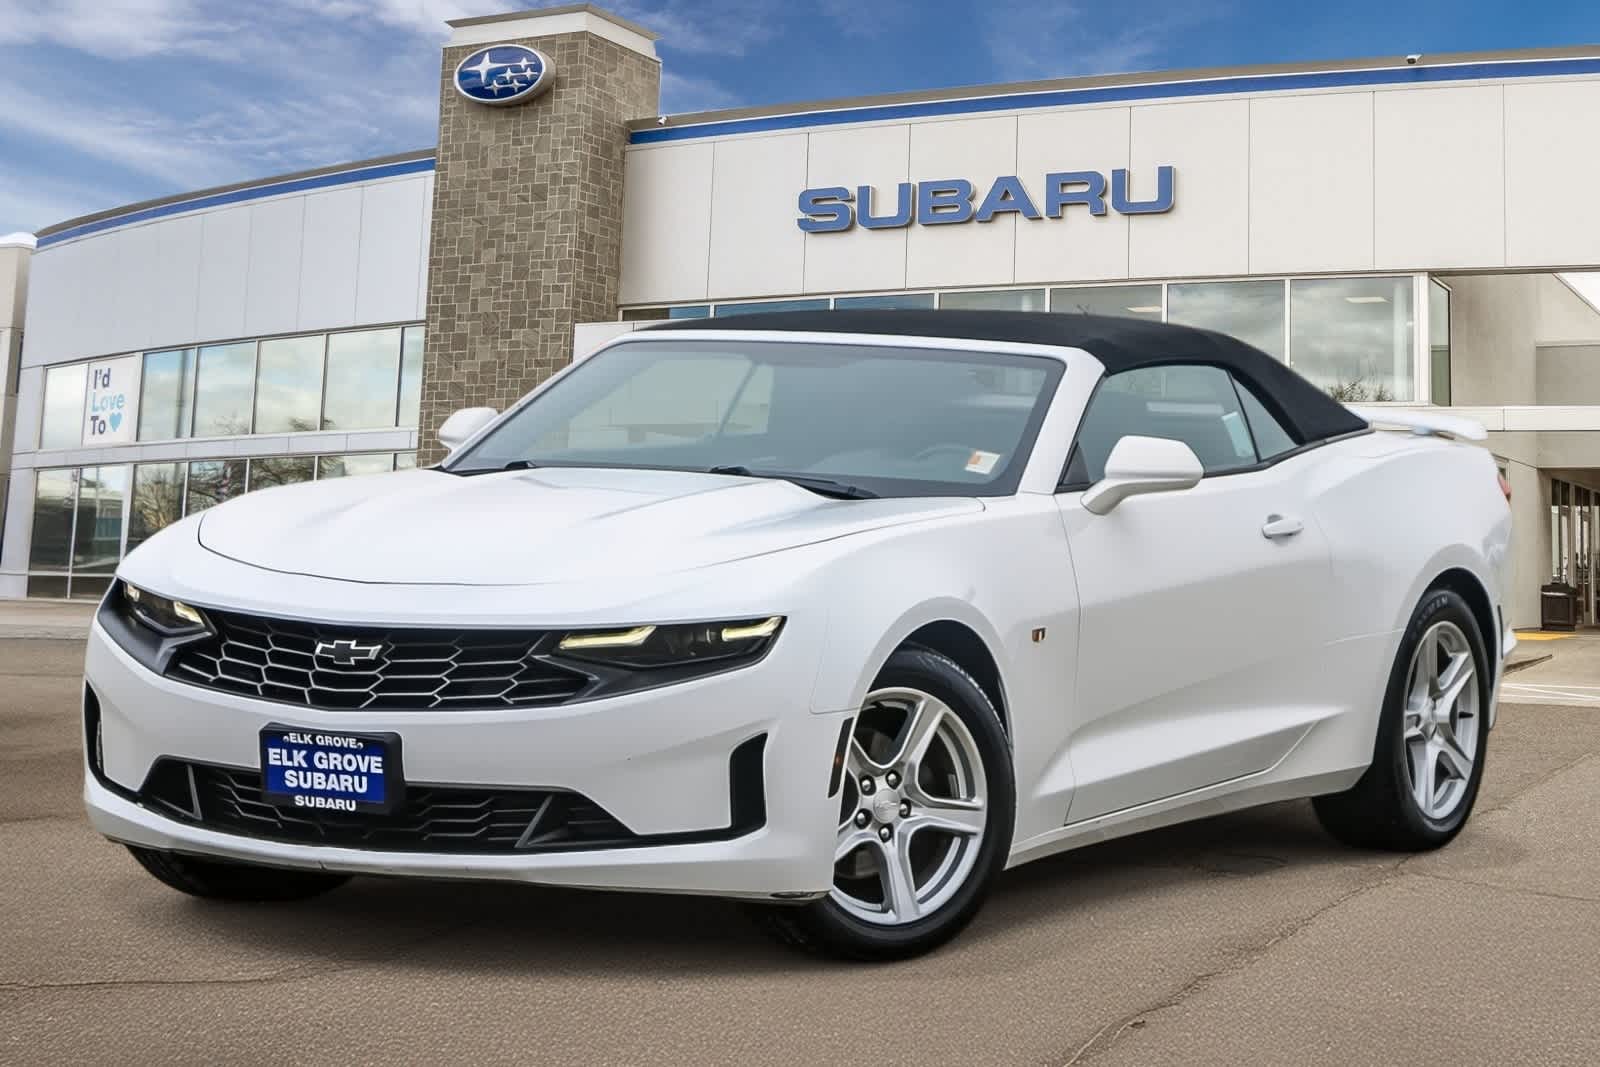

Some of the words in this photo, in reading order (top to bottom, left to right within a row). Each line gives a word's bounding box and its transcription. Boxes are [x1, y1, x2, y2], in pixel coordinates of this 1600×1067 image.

[797, 165, 1176, 233] SUBARU
[93, 367, 111, 390] I'd
[91, 392, 126, 412] Love
[90, 415, 106, 435] To
[289, 732, 313, 745] ELK
[315, 735, 357, 749] GROVE
[267, 747, 308, 768] ELK
[313, 751, 384, 774] GROVE
[284, 769, 368, 794] SUBARU
[293, 795, 357, 812] SUBARU
